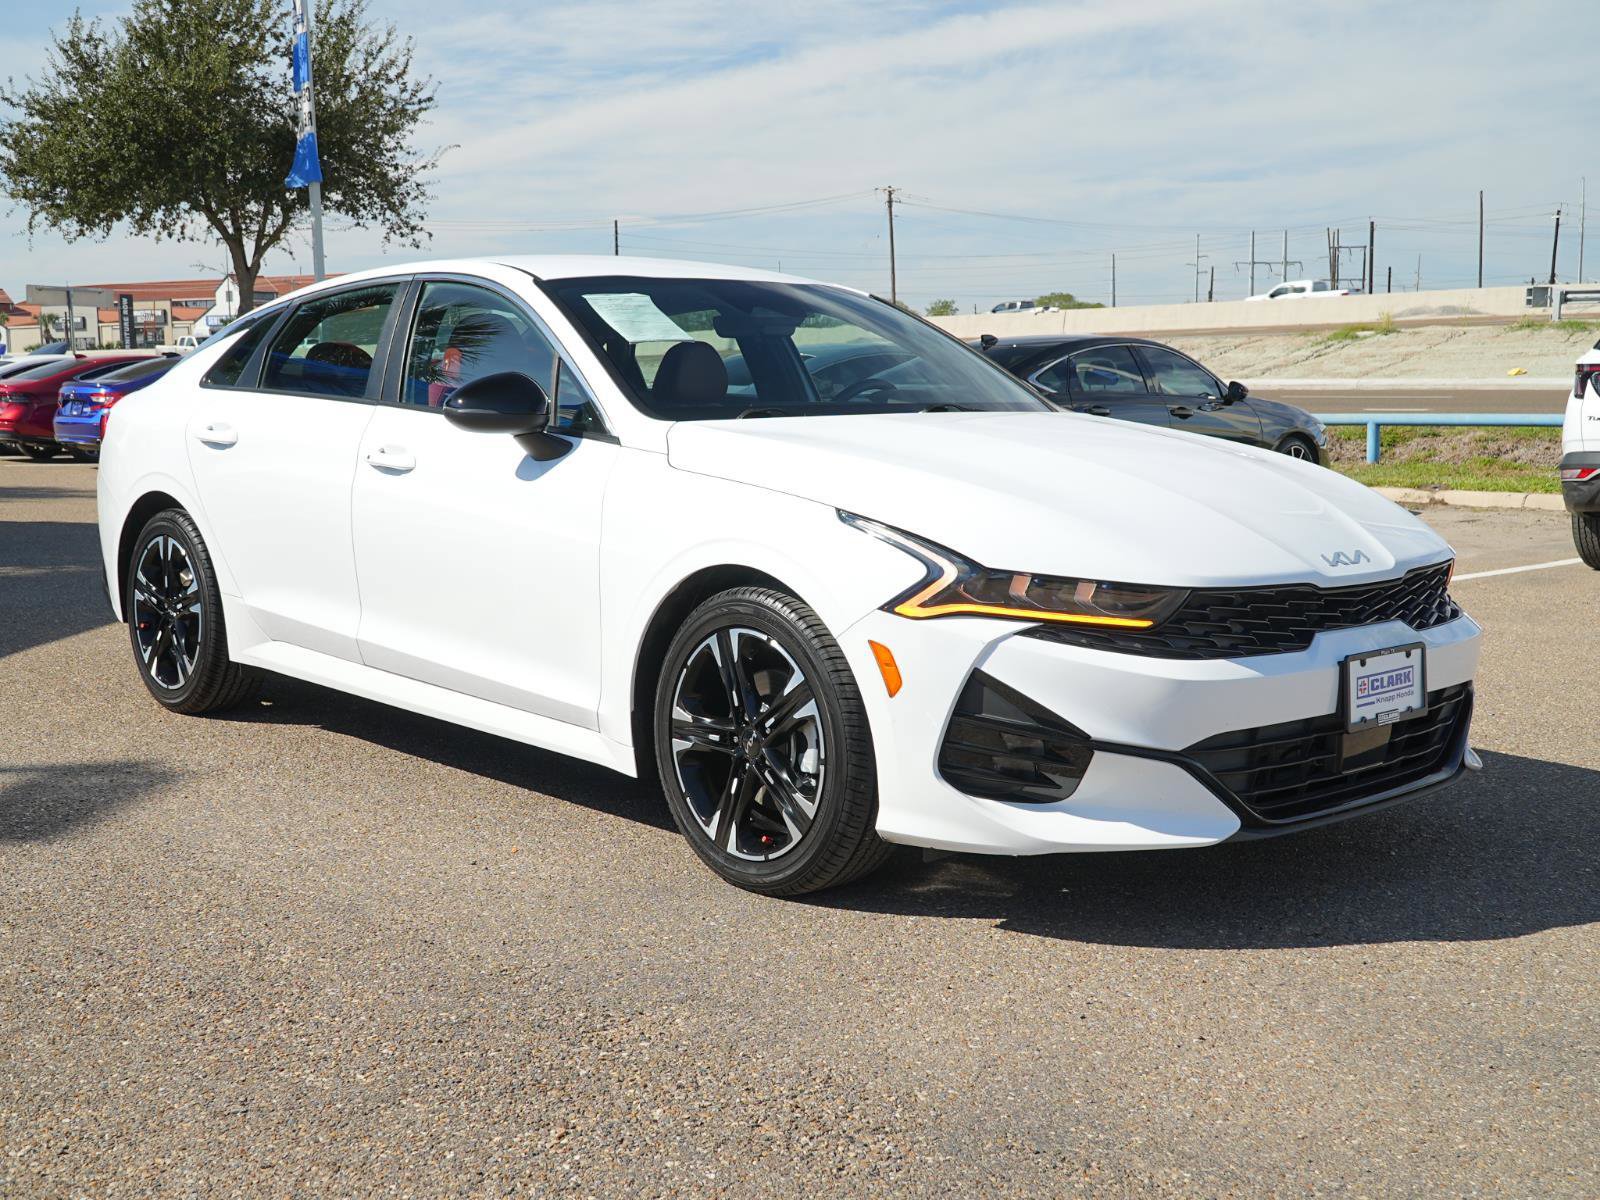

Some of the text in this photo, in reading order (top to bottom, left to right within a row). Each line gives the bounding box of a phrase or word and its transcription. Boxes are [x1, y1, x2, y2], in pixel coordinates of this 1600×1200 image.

[121, 297, 129, 315] ROW
[1320, 549, 1371, 567] KIA
[1370, 670, 1412, 691] CLARK
[1376, 688, 1415, 704] Knapp Honda
